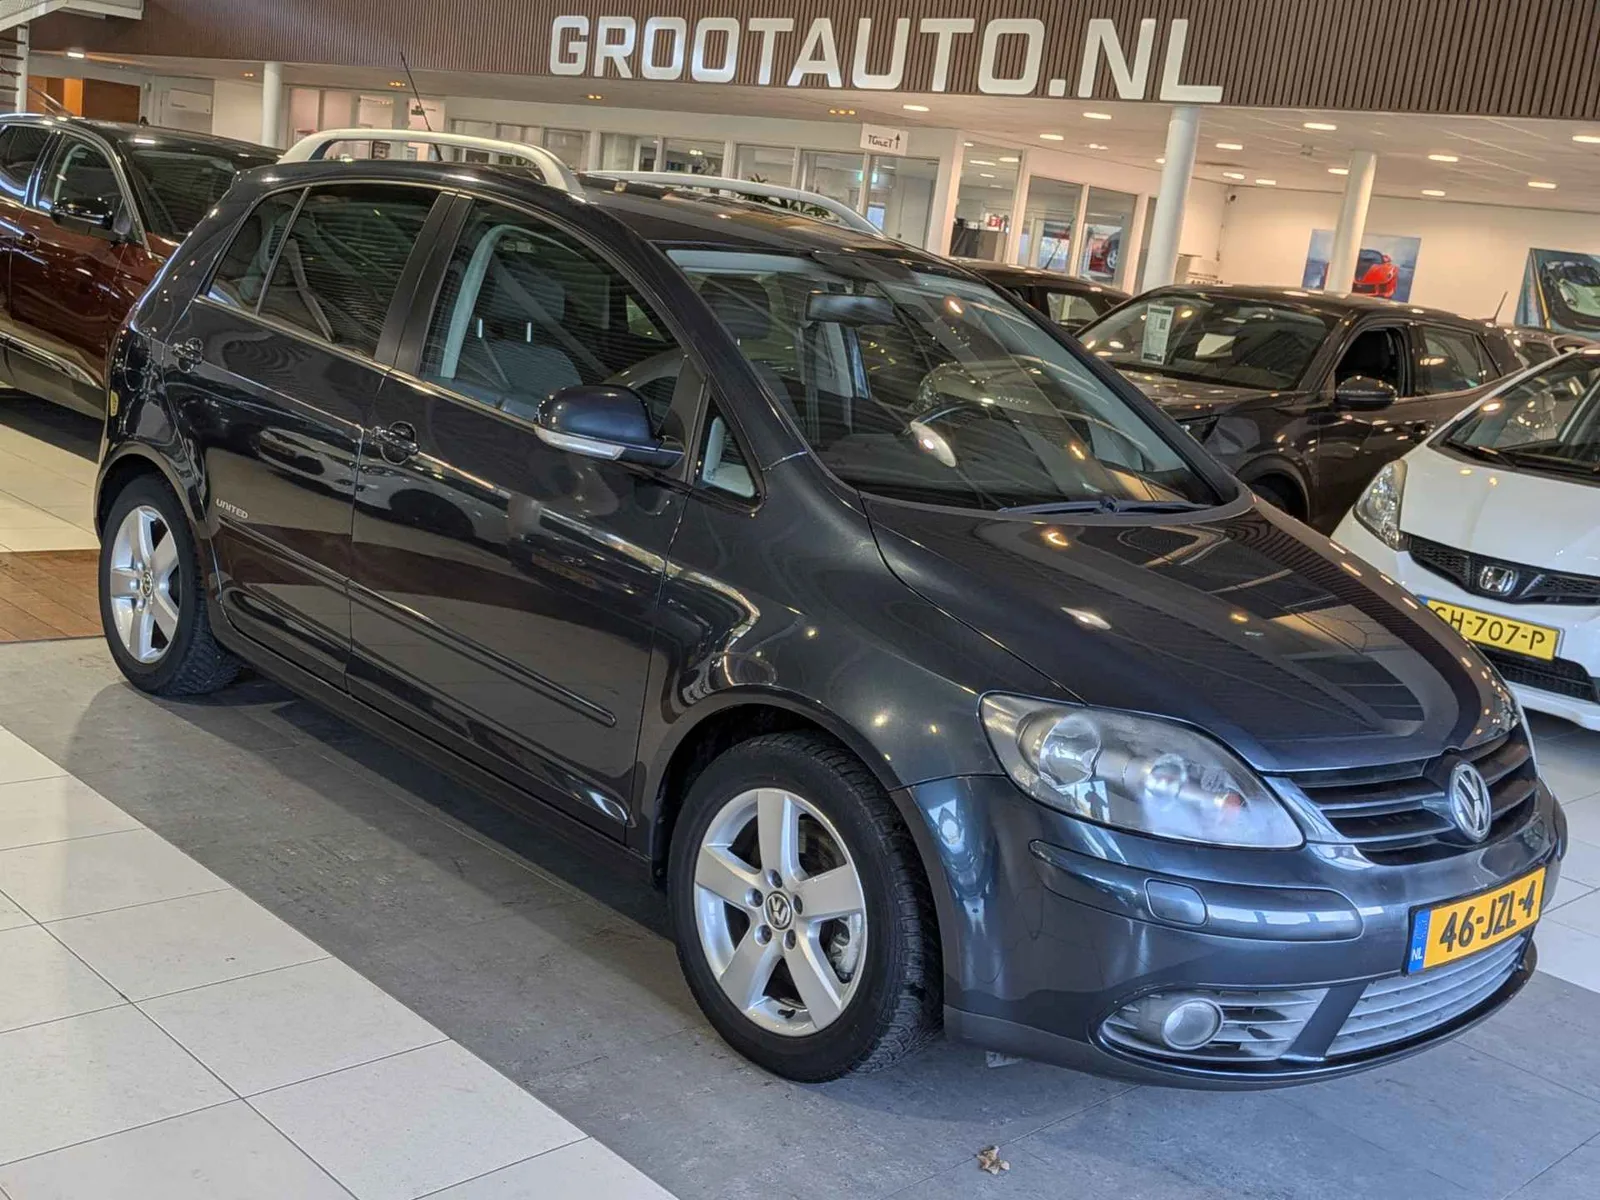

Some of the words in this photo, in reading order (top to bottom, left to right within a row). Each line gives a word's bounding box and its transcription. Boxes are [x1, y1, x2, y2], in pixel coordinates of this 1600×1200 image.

[550, 15, 1223, 103] GROOTAUTO.NL
[216, 498, 249, 519] UNITED
[1439, 880, 1536, 953] 46-JZL-4
[1411, 947, 1423, 961] NL
